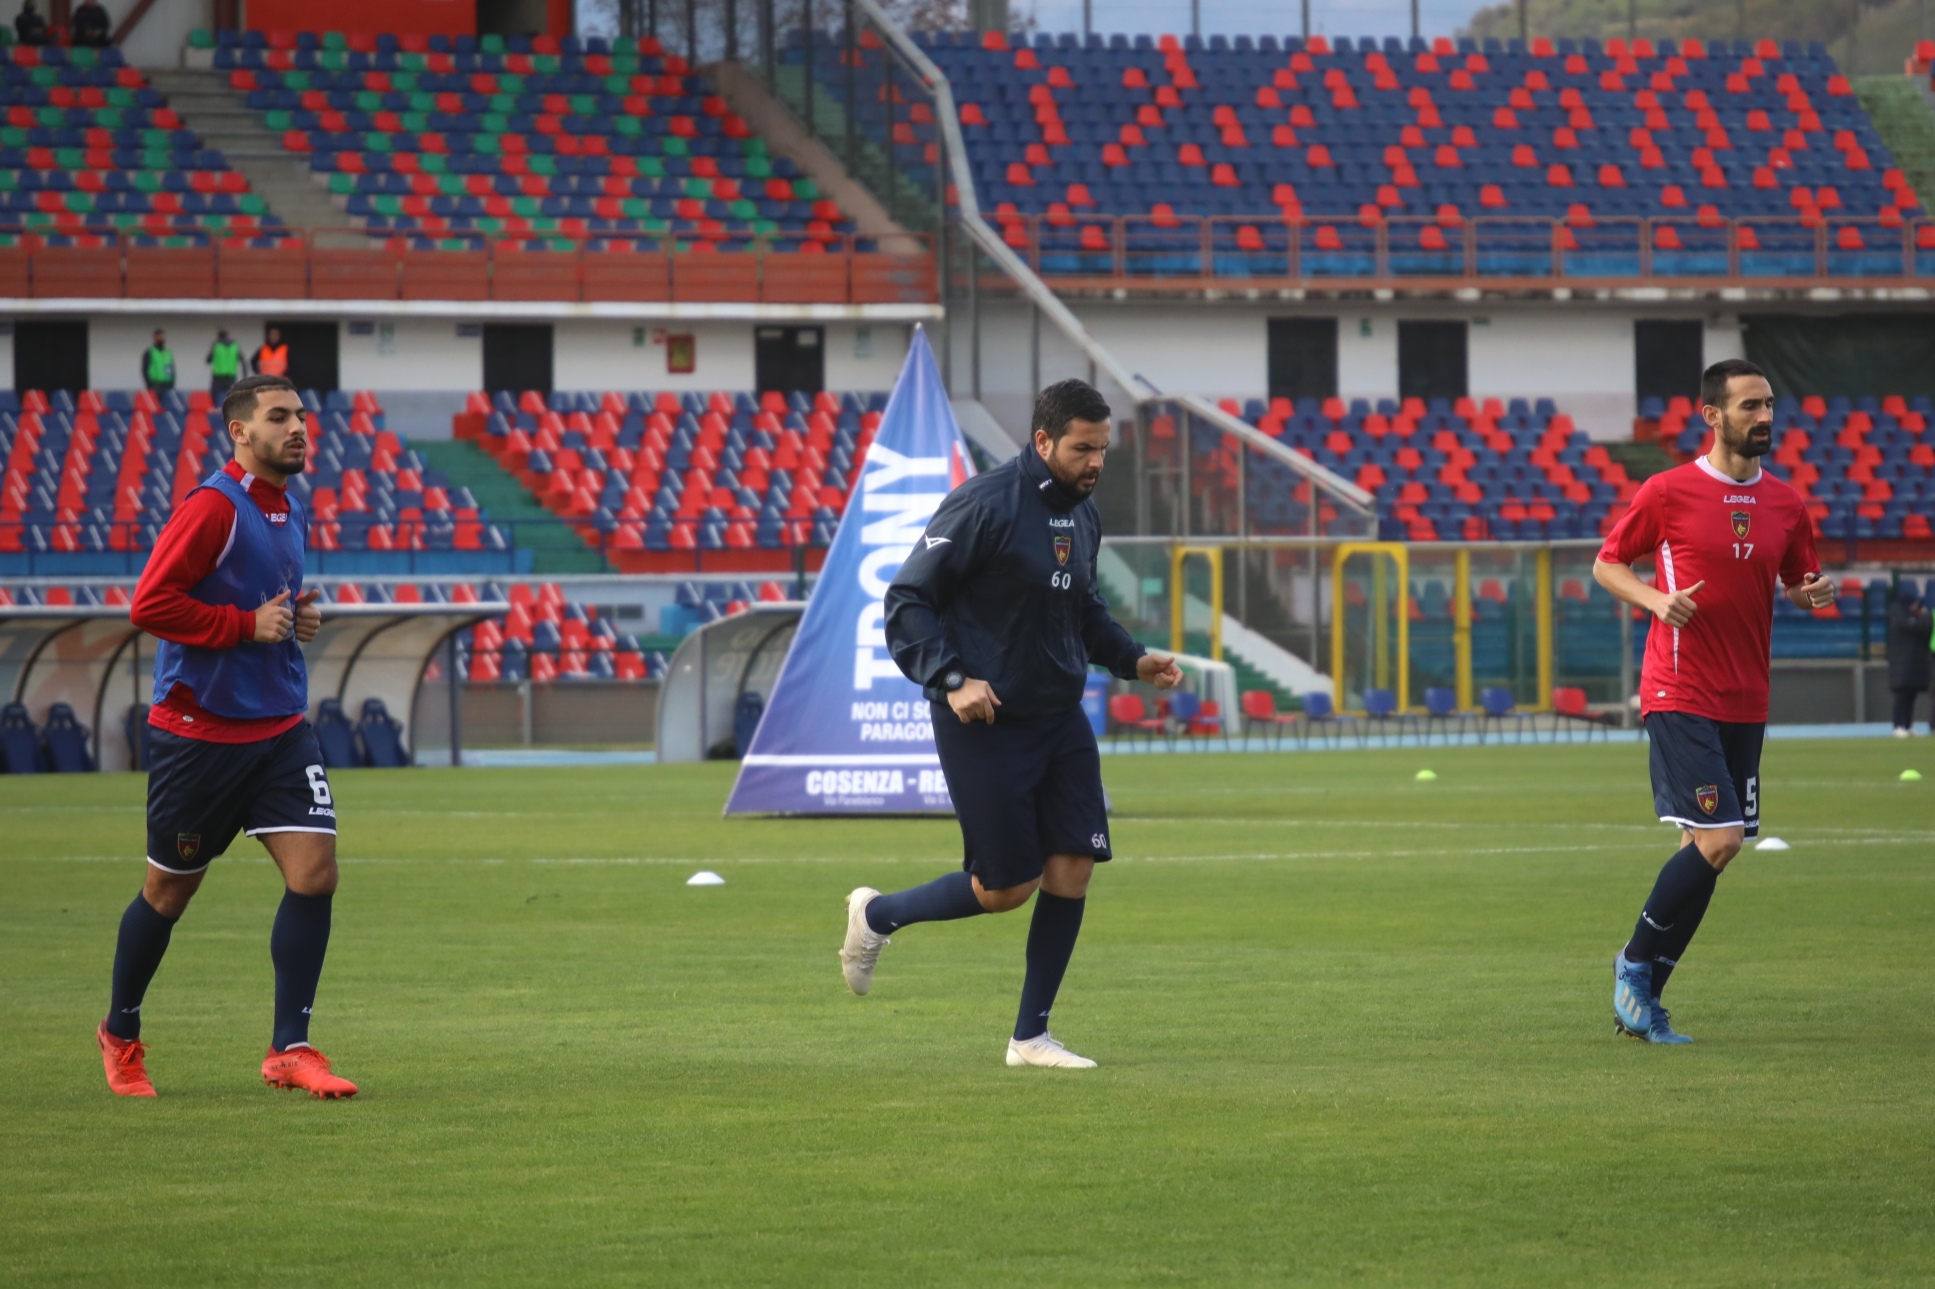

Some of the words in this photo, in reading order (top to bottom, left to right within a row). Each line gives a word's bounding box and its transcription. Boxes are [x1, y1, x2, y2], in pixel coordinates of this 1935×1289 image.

[1723, 495, 1756, 504] LEGEA
[1049, 518, 1075, 527] LEGEA
[1733, 543, 1754, 559] 17
[1051, 571, 1071, 589] 60
[851, 702, 888, 720] NON
[892, 701, 909, 719] CI
[305, 764, 331, 804] 6
[806, 771, 904, 794] COSENZA
[1744, 776, 1757, 816] 5
[1091, 833, 1106, 849] 60
